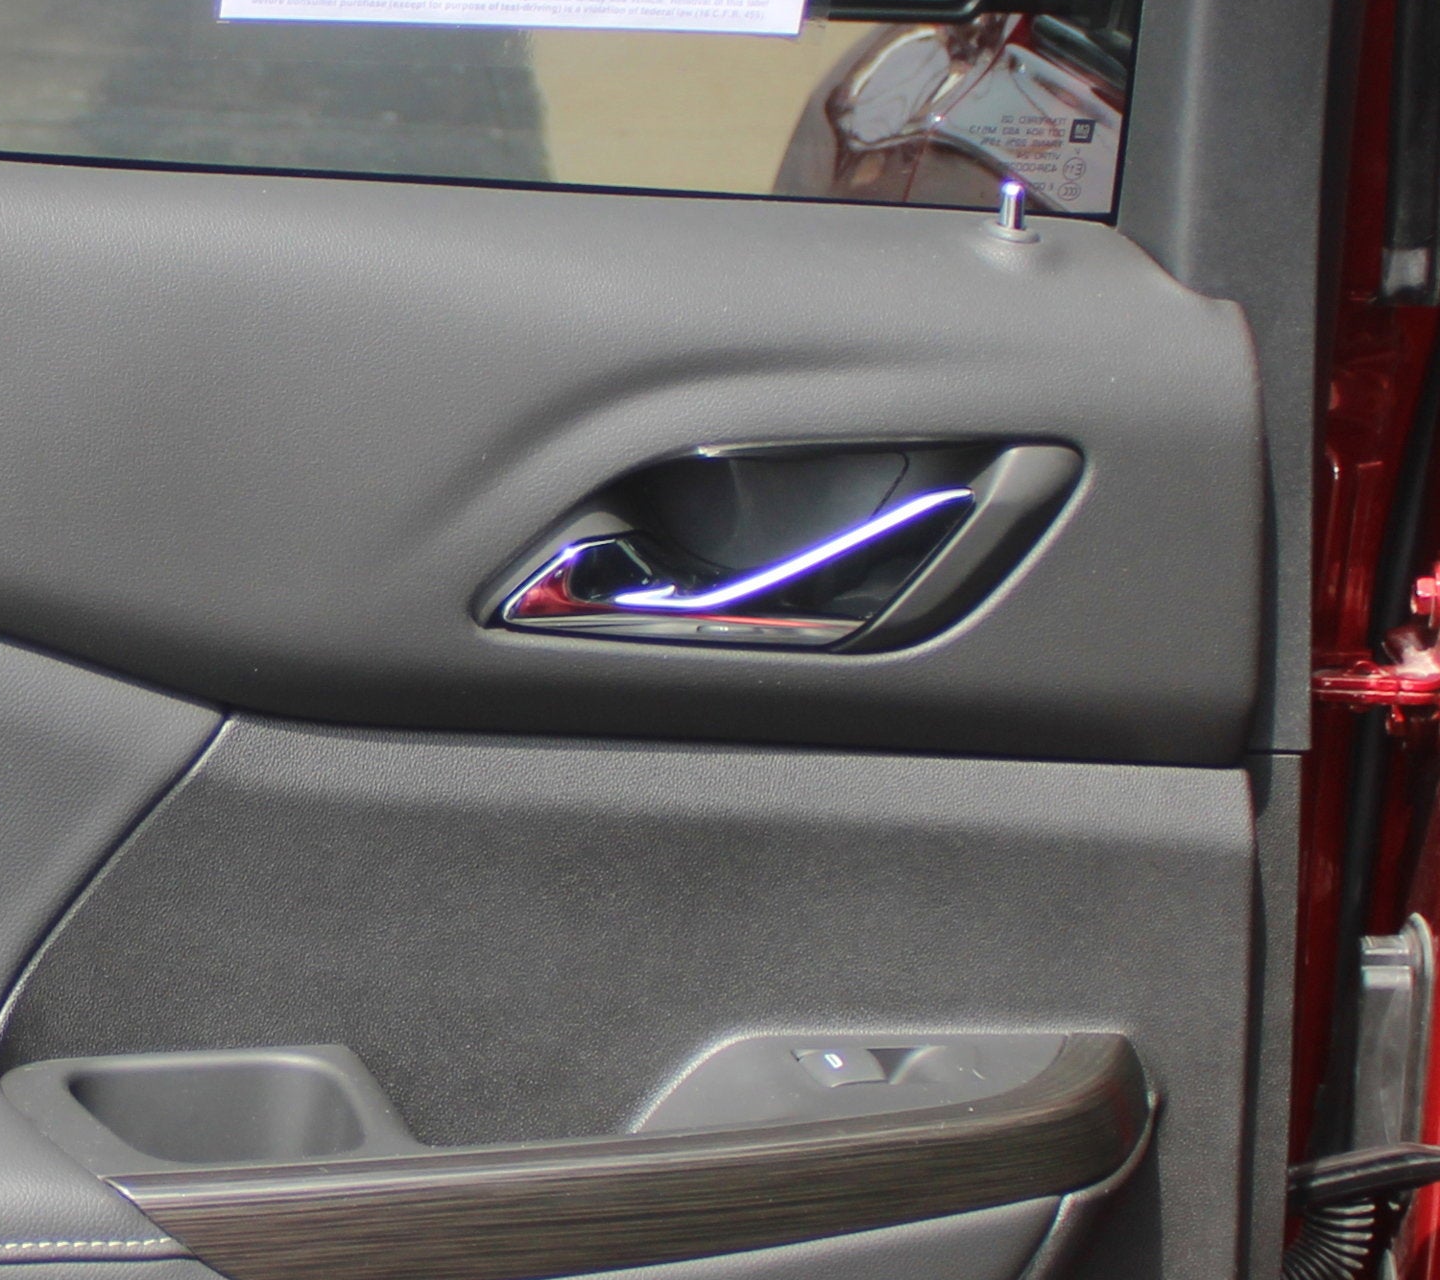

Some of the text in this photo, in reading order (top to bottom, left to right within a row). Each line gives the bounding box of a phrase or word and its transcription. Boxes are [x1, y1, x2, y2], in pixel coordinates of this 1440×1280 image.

[339, 0, 386, 7] purchase
[388, 0, 425, 9] (except
[444, 2, 485, 10] purpose
[488, 2, 499, 10] of
[500, 3, 561, 13] test-driving)
[583, 5, 625, 13] violation
[640, 7, 674, 16] federal
[676, 9, 692, 17] law
